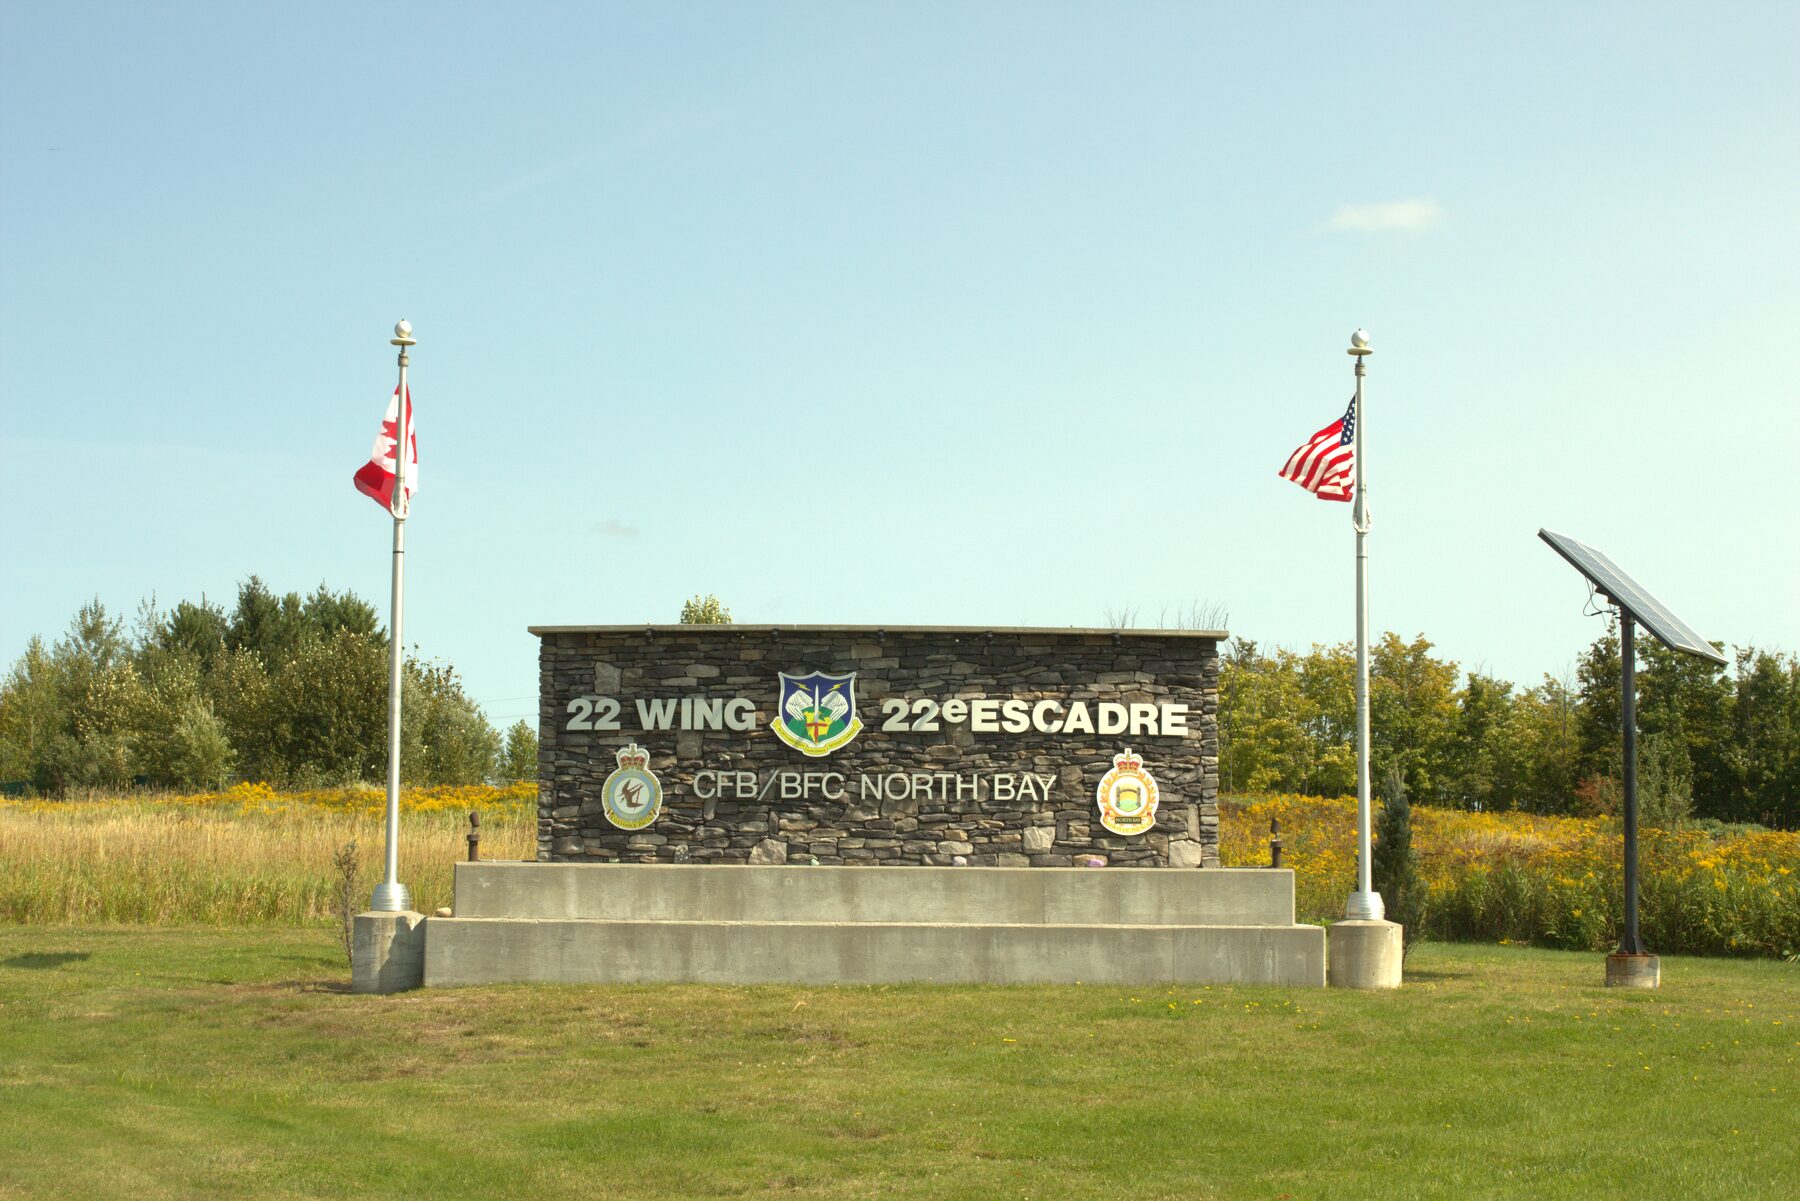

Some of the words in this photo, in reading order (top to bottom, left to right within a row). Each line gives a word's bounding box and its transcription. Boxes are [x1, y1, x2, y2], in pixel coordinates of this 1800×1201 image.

[566, 698, 621, 730] 22
[636, 698, 757, 731] WING
[693, 769, 845, 801] CFB/BFC
[861, 772, 978, 801] NORTH
[994, 772, 1057, 801] BAY
